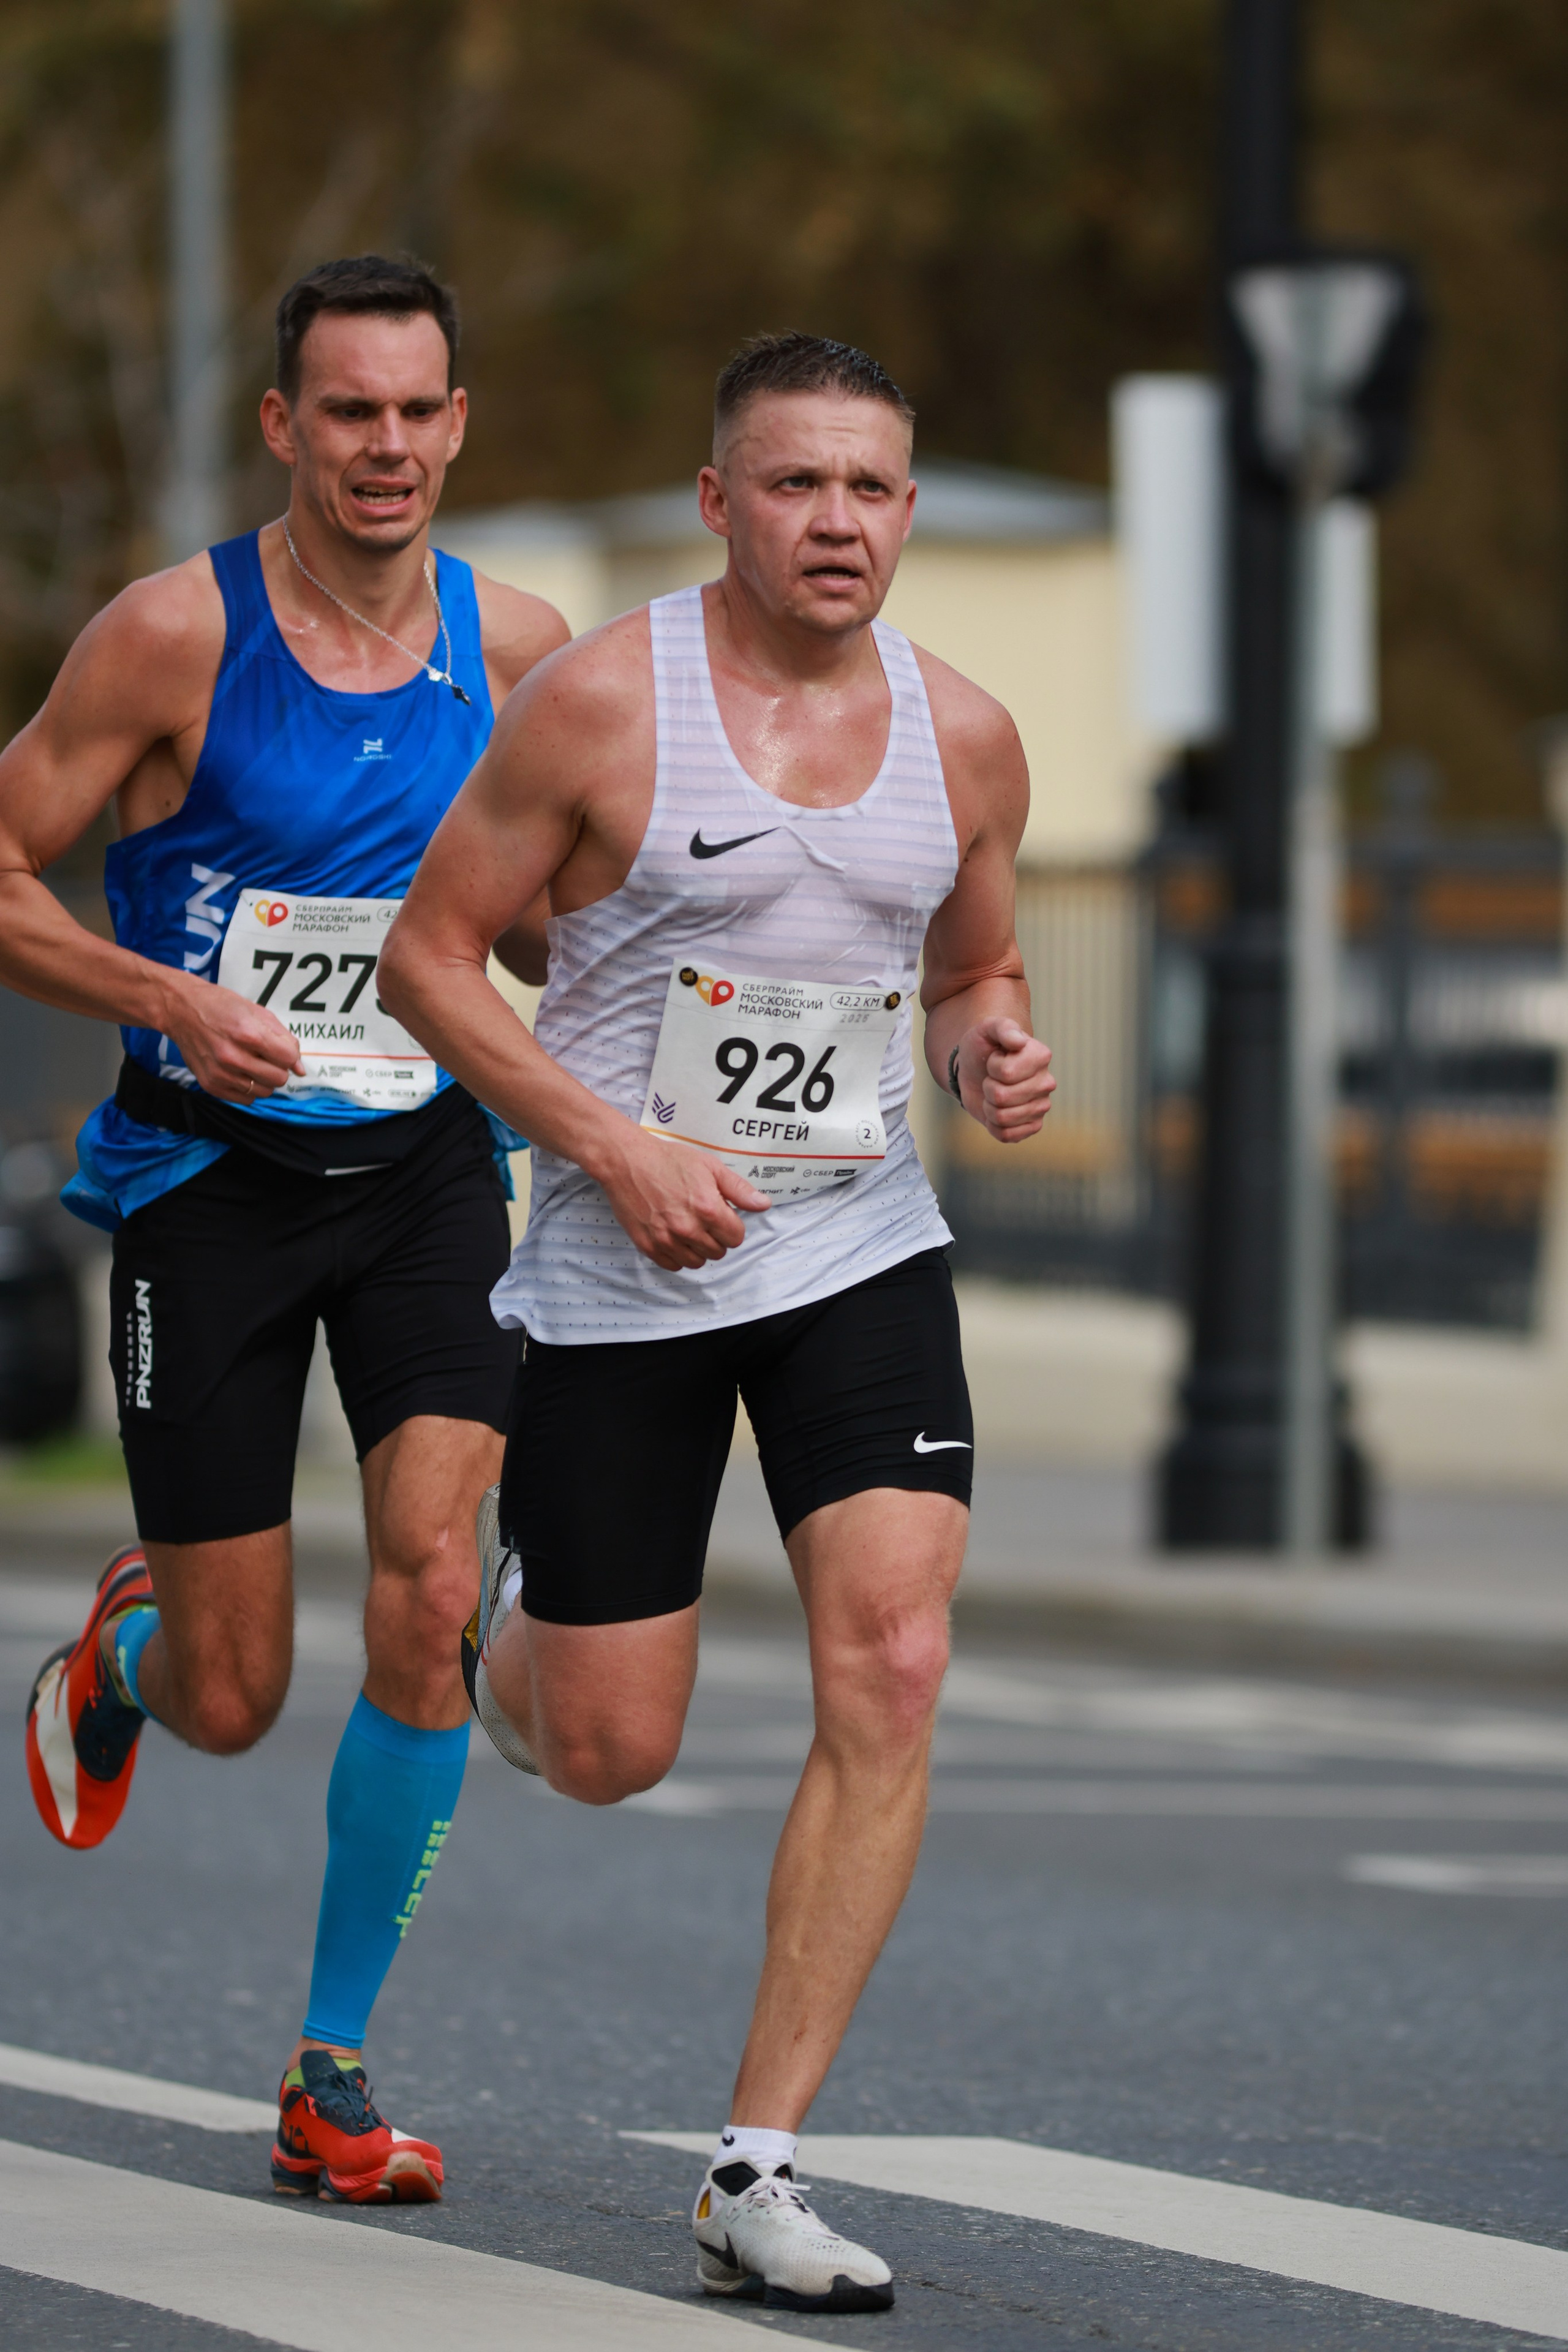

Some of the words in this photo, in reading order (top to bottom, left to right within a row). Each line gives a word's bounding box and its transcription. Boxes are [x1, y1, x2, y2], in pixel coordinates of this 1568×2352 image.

[295, 904, 352, 913] СБЕРПРАЙМ
[294, 913, 371, 923] МОСКОВСКИЙ
[292, 922, 349, 933] МАРАФОН
[252, 949, 392, 1017] 727
[742, 983, 803, 996] СБЕРПРАЙМ
[740, 993, 823, 1010] МОСКОВСКИЙ
[837, 996, 861, 1007] 42,2
[737, 1004, 801, 1019] МАРАФОН
[289, 1022, 365, 1041] МИХАИЛ
[715, 1037, 837, 1113] 926
[731, 1118, 809, 1141] СЕРГЕЙ
[864, 1128, 871, 1139] 2
[135, 1279, 152, 1409] PNZRUN
